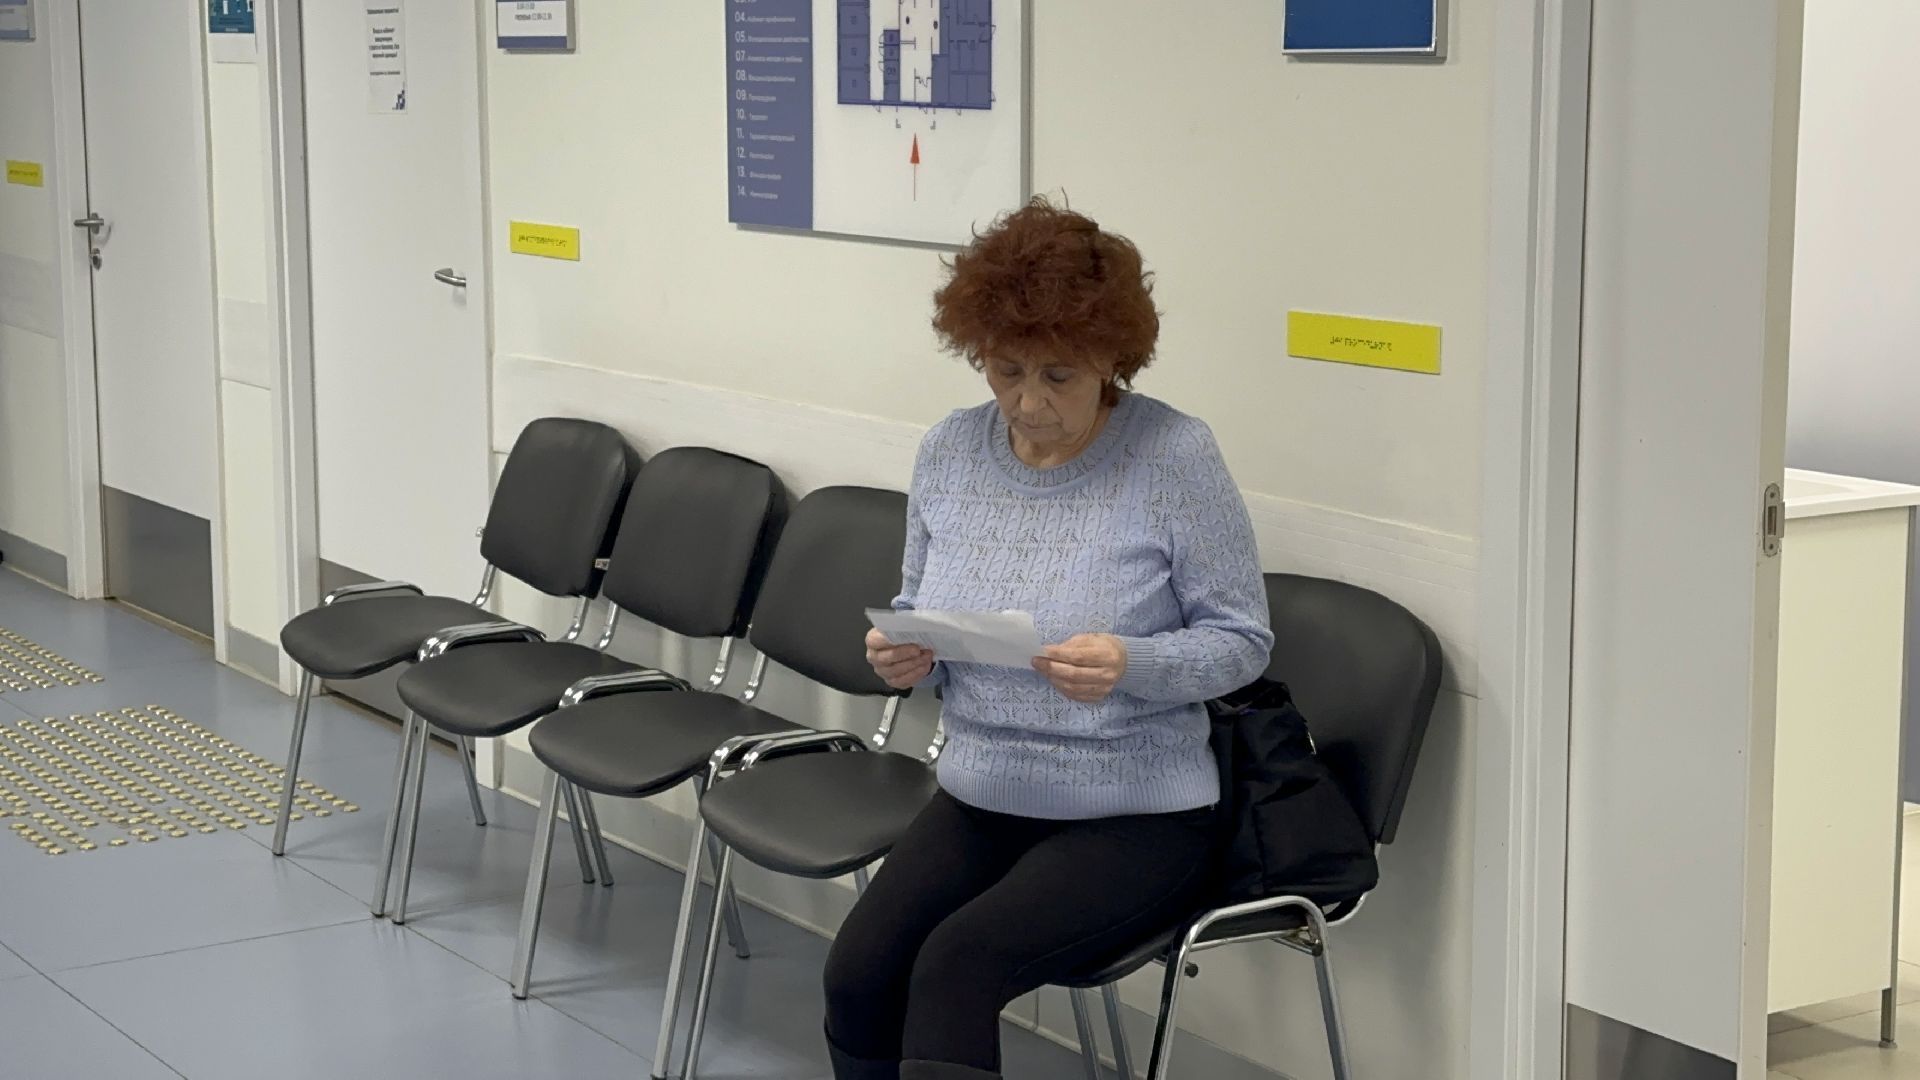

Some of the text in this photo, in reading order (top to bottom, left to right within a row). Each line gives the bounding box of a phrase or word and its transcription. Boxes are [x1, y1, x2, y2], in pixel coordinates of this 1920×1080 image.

[735, 11, 748, 23] 04.
[735, 30, 747, 43] 05.
[736, 50, 748, 63] 07.
[736, 69, 748, 82] 08.
[736, 89, 748, 101] 09.
[736, 107, 747, 121] 10.
[736, 127, 745, 139] 11.
[736, 146, 747, 159] 12.
[737, 165, 747, 178] 13.
[737, 184, 748, 198] 14.
